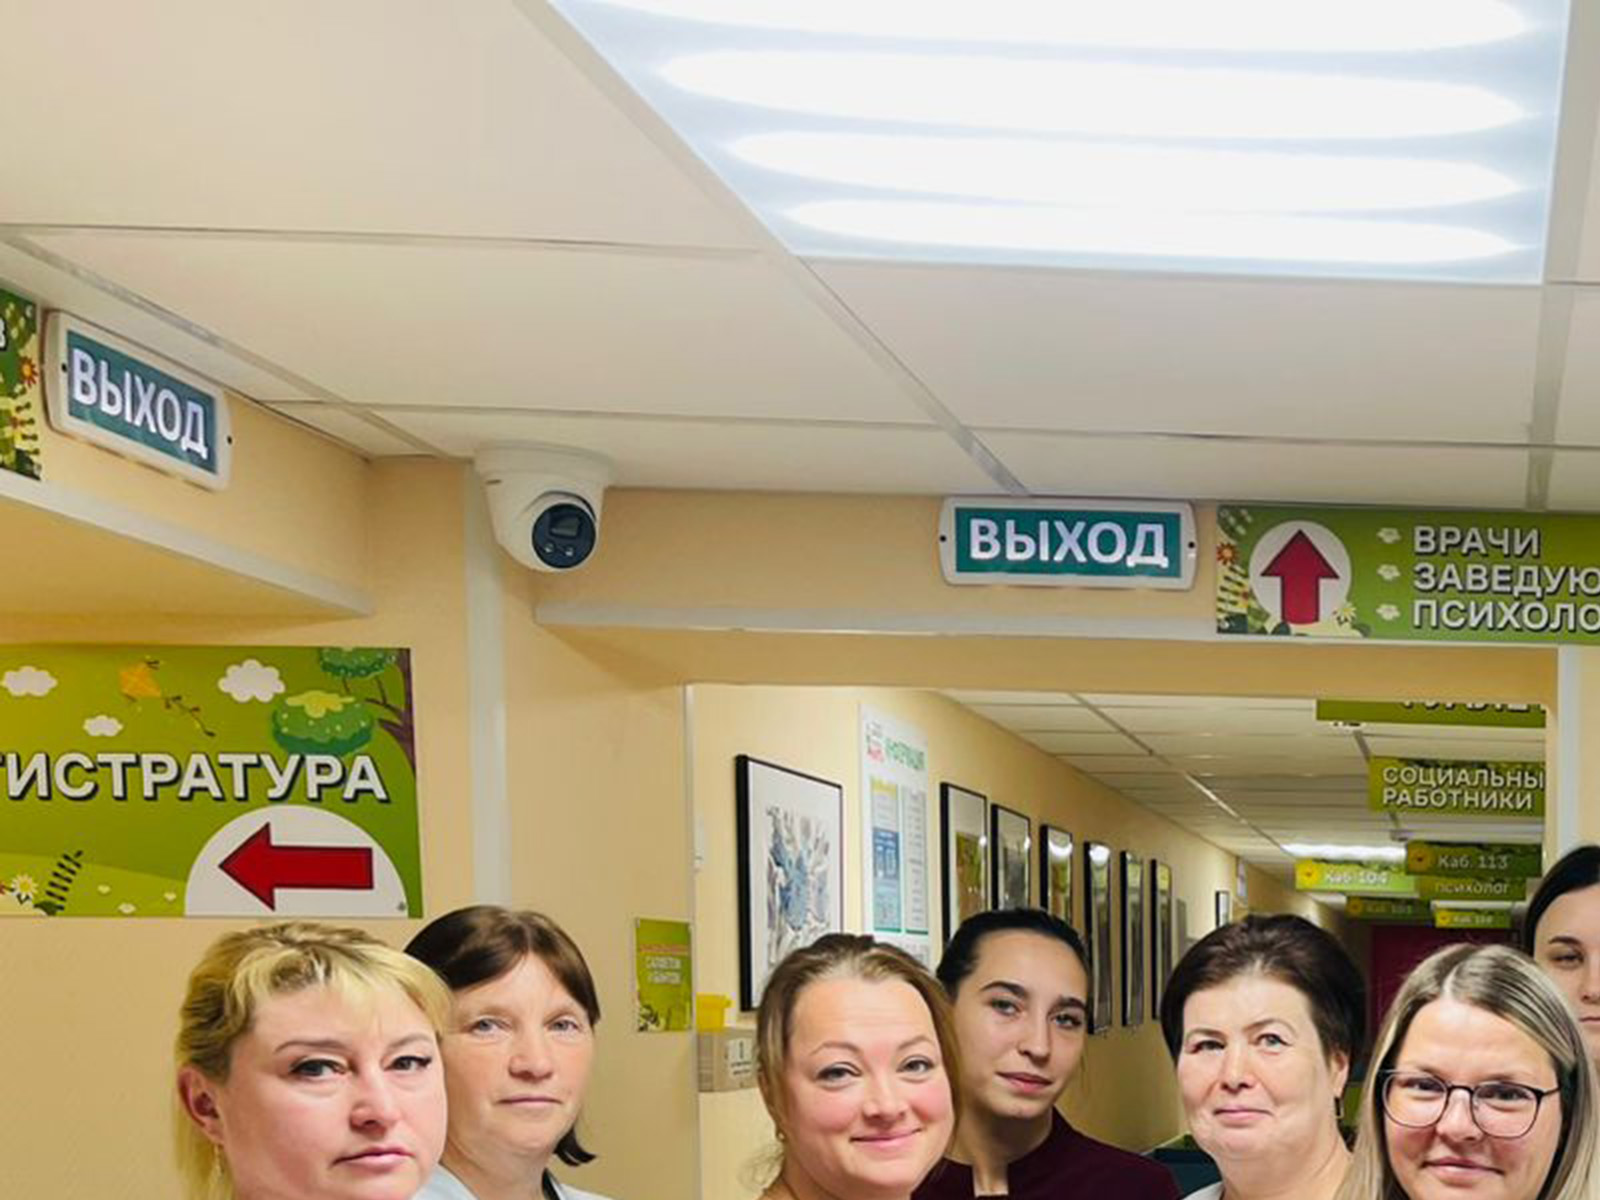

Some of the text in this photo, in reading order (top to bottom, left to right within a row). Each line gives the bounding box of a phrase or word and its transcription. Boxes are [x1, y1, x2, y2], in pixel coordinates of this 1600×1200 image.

[71, 347, 209, 460] ВЫХОД
[968, 518, 1170, 567] ВЫХОД
[1413, 526, 1541, 557] ВРАЧИ
[0, 752, 388, 801] ИСТРАТУРА
[1383, 768, 1544, 789] СОЦИАЛЬНЫ
[1383, 789, 1533, 810] РАБОТНИКИ
[1438, 855, 1508, 869] Каб. 113
[1436, 882, 1508, 894] психолог
